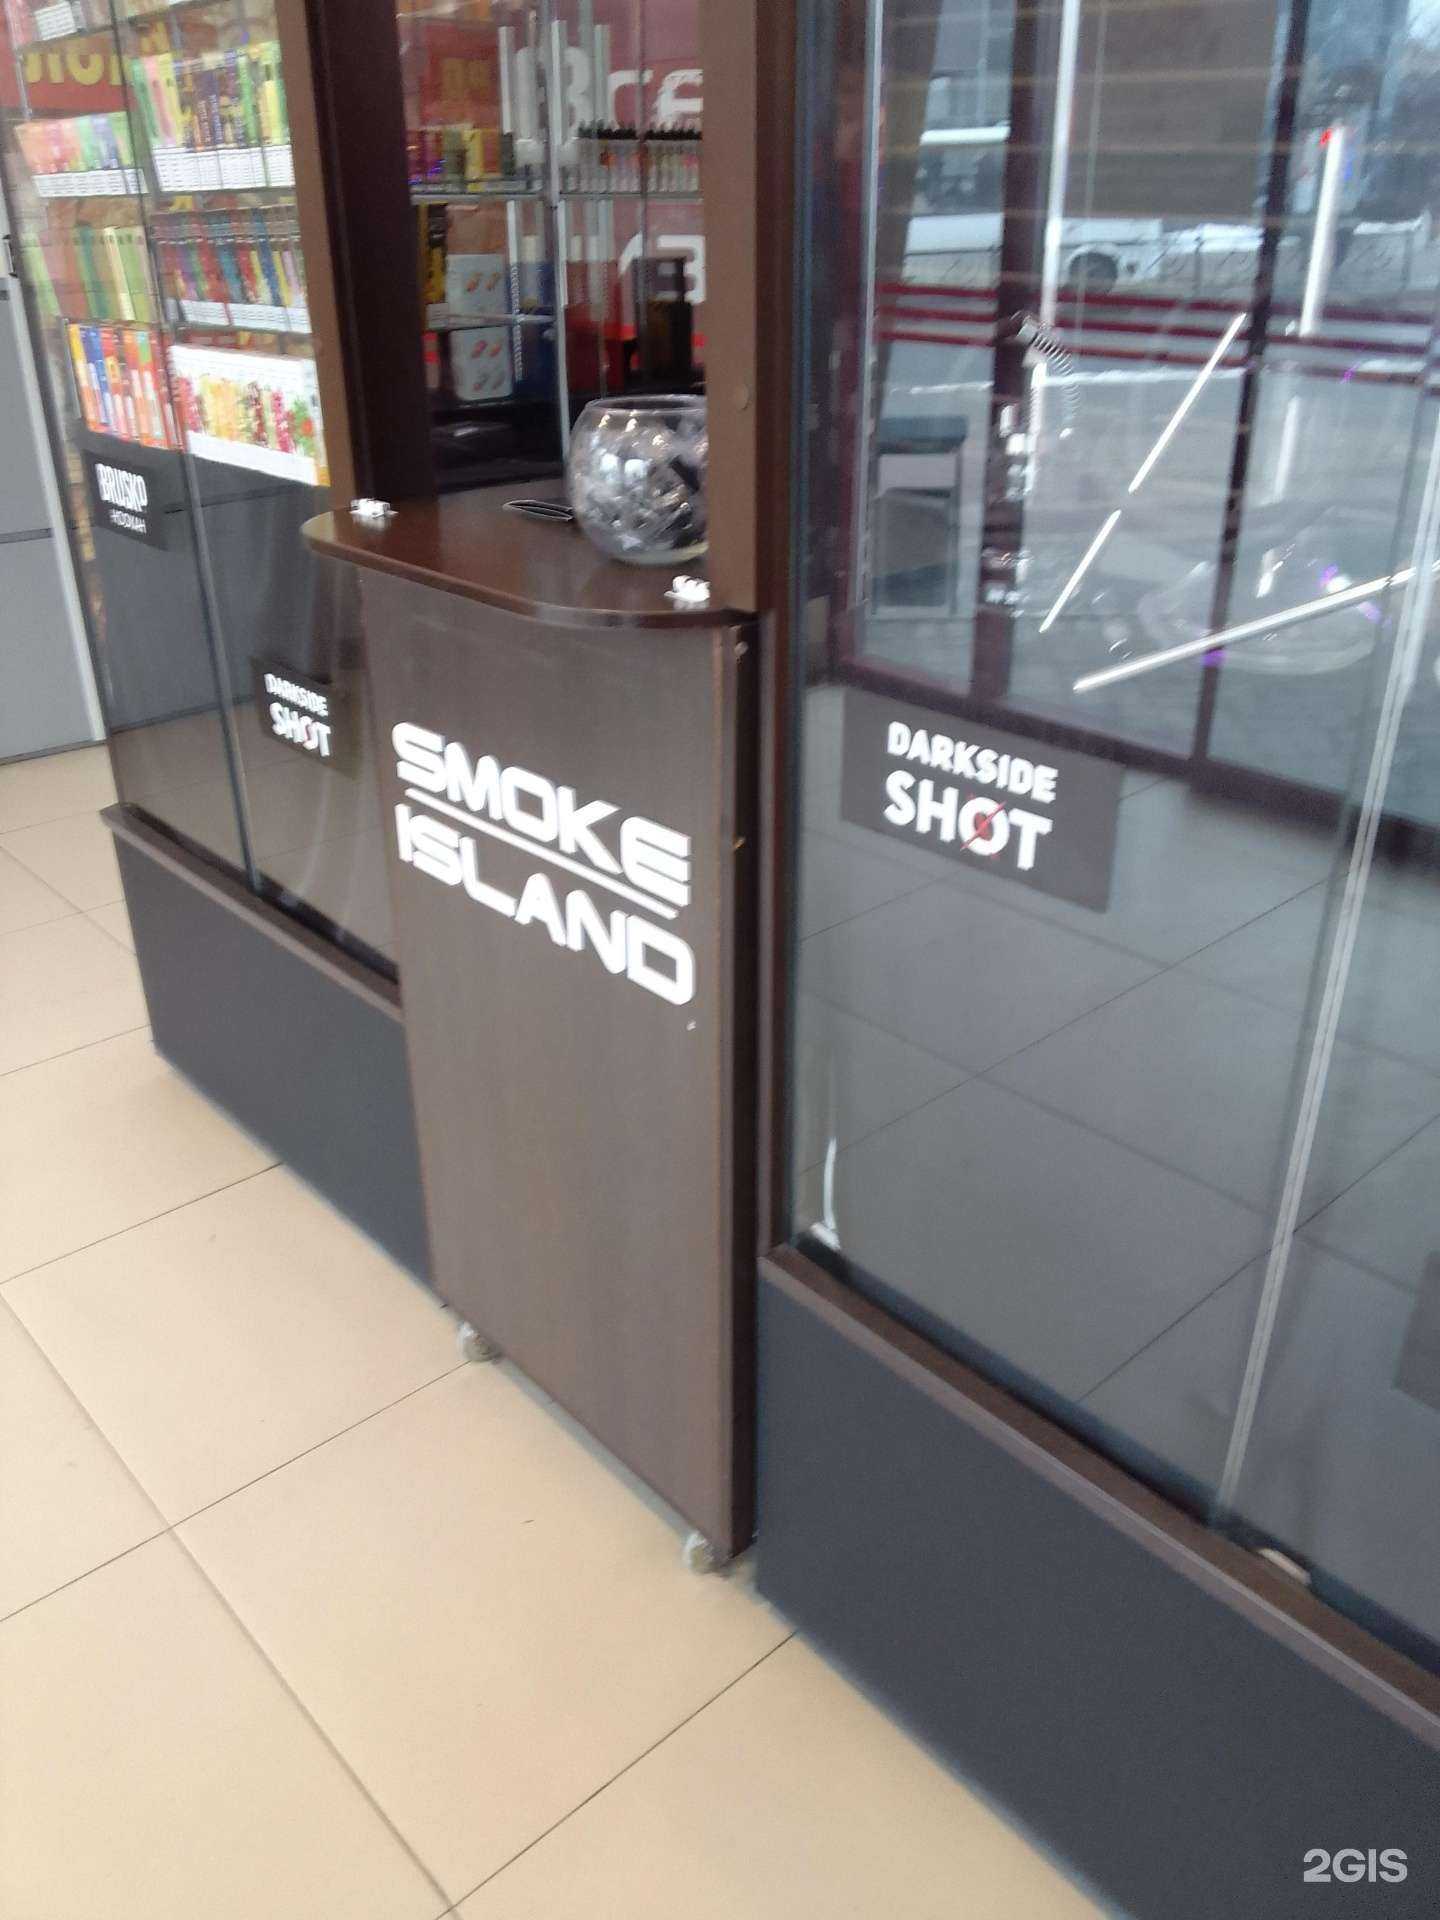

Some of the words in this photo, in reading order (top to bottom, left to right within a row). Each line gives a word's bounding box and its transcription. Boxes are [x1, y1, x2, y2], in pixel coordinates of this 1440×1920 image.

[95, 463, 148, 512] BRUSKO
[269, 702, 331, 757] SHOT
[887, 721, 1058, 804] DARKSIDE
[392, 722, 691, 907] SMOKE
[883, 769, 1053, 871] SHOT
[394, 803, 696, 1005] ISLAND
